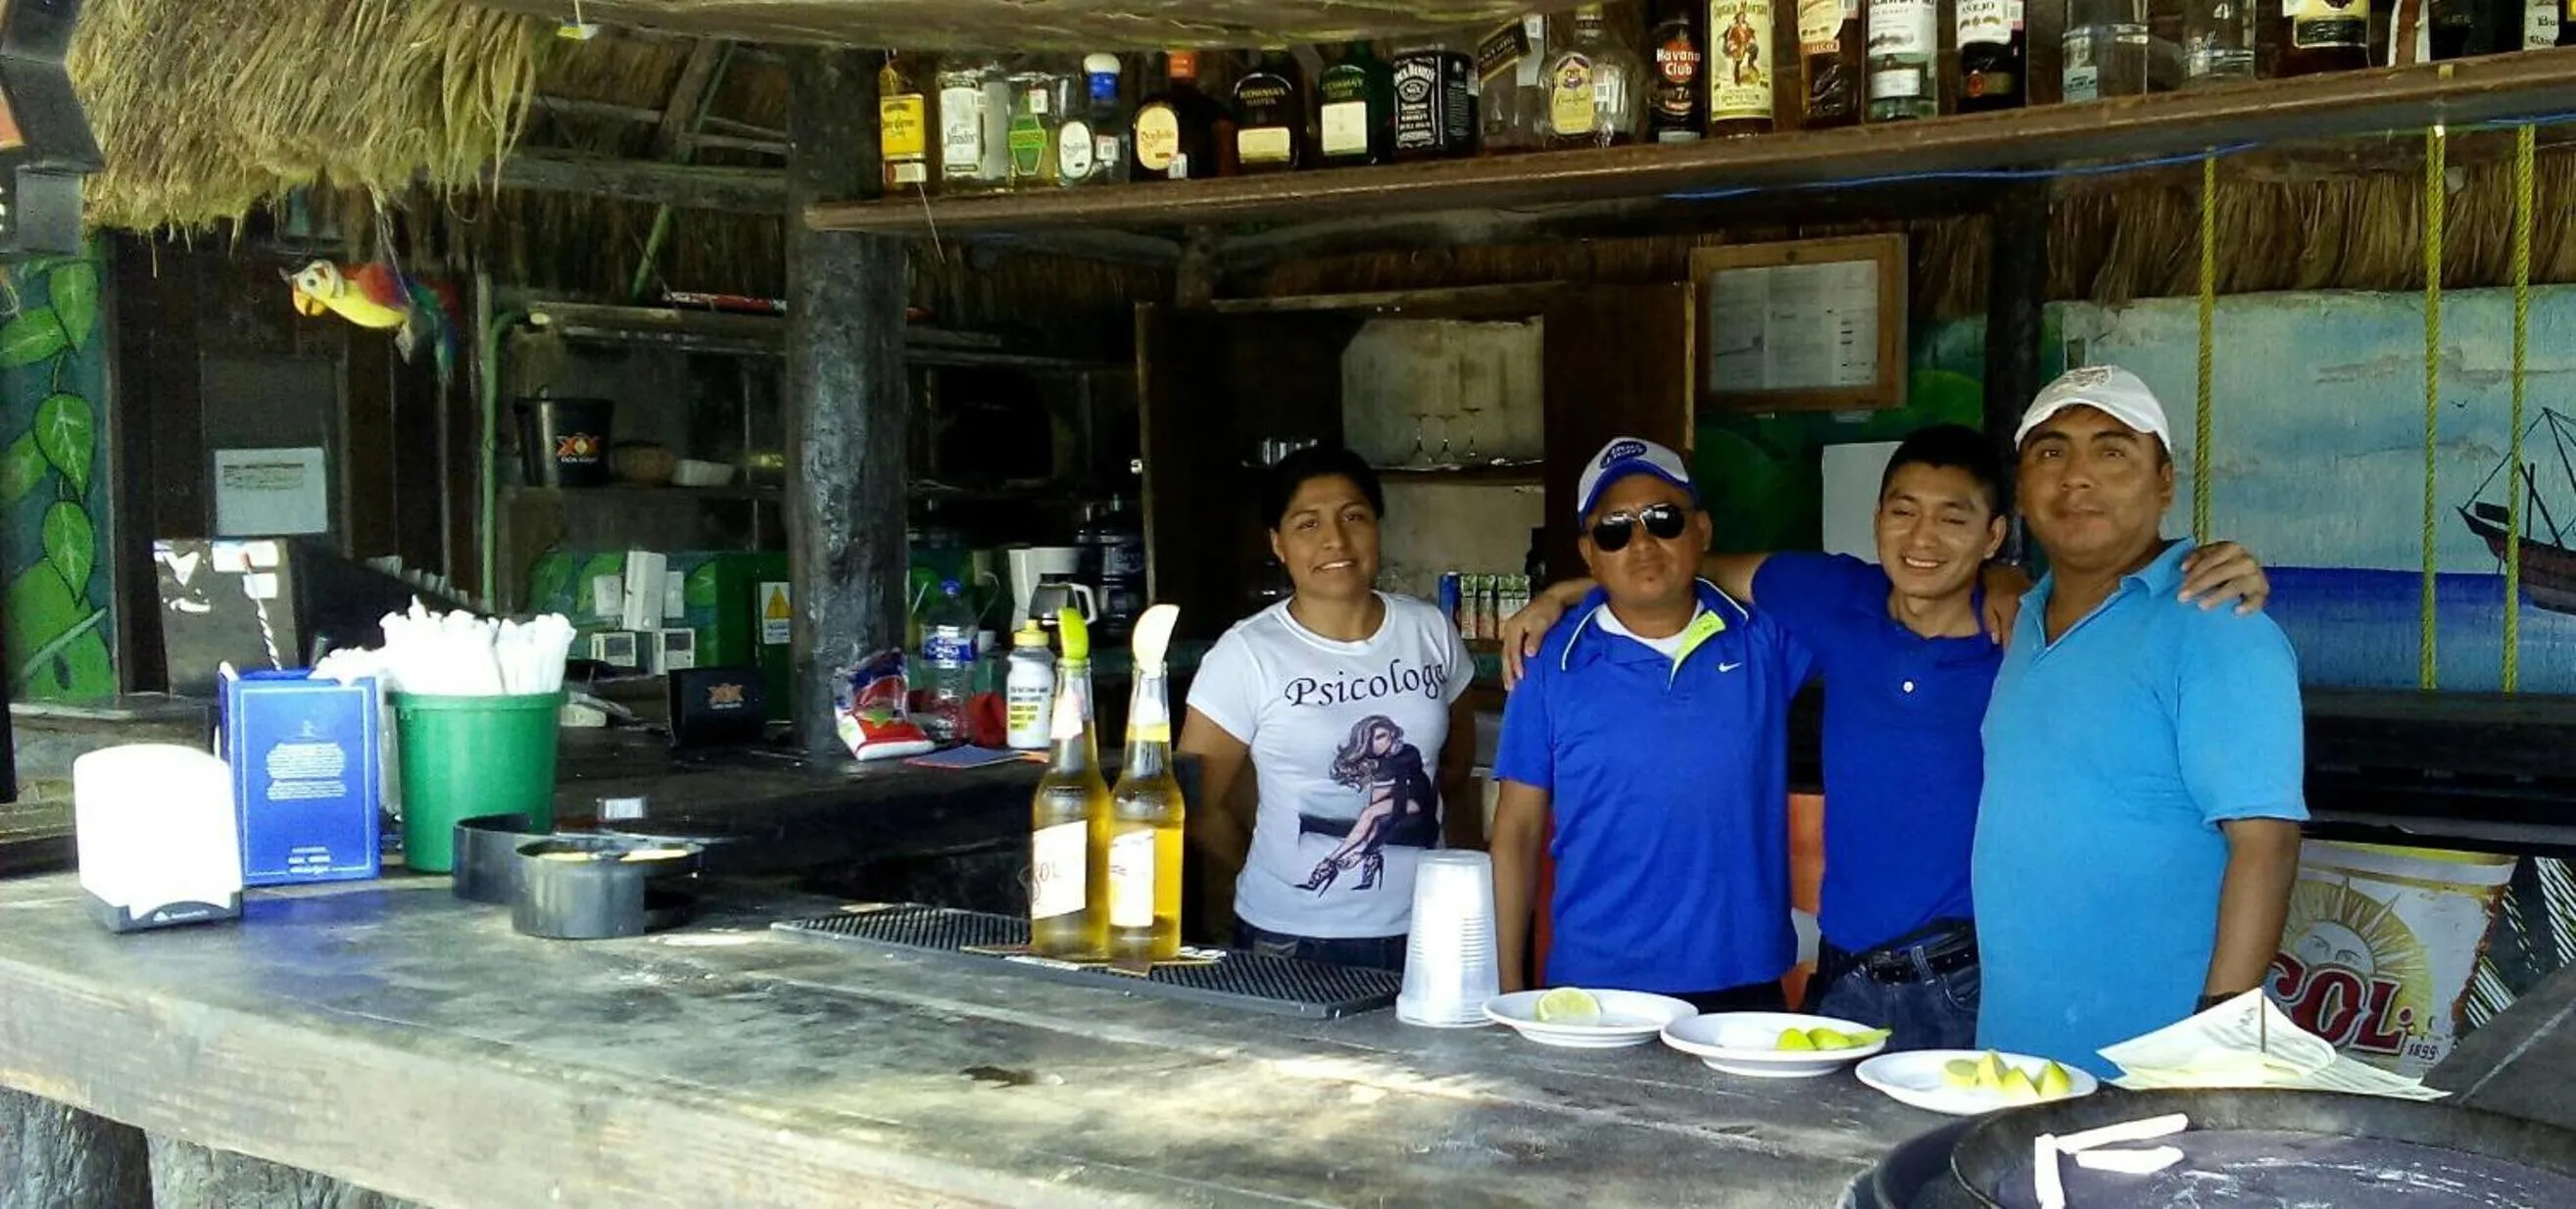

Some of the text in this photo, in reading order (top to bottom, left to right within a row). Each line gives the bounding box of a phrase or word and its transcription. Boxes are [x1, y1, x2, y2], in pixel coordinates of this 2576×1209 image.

[1656, 48, 1701, 63] Havana
[1665, 63, 1693, 75] Club
[2407, 1042, 2439, 1060] 1899
